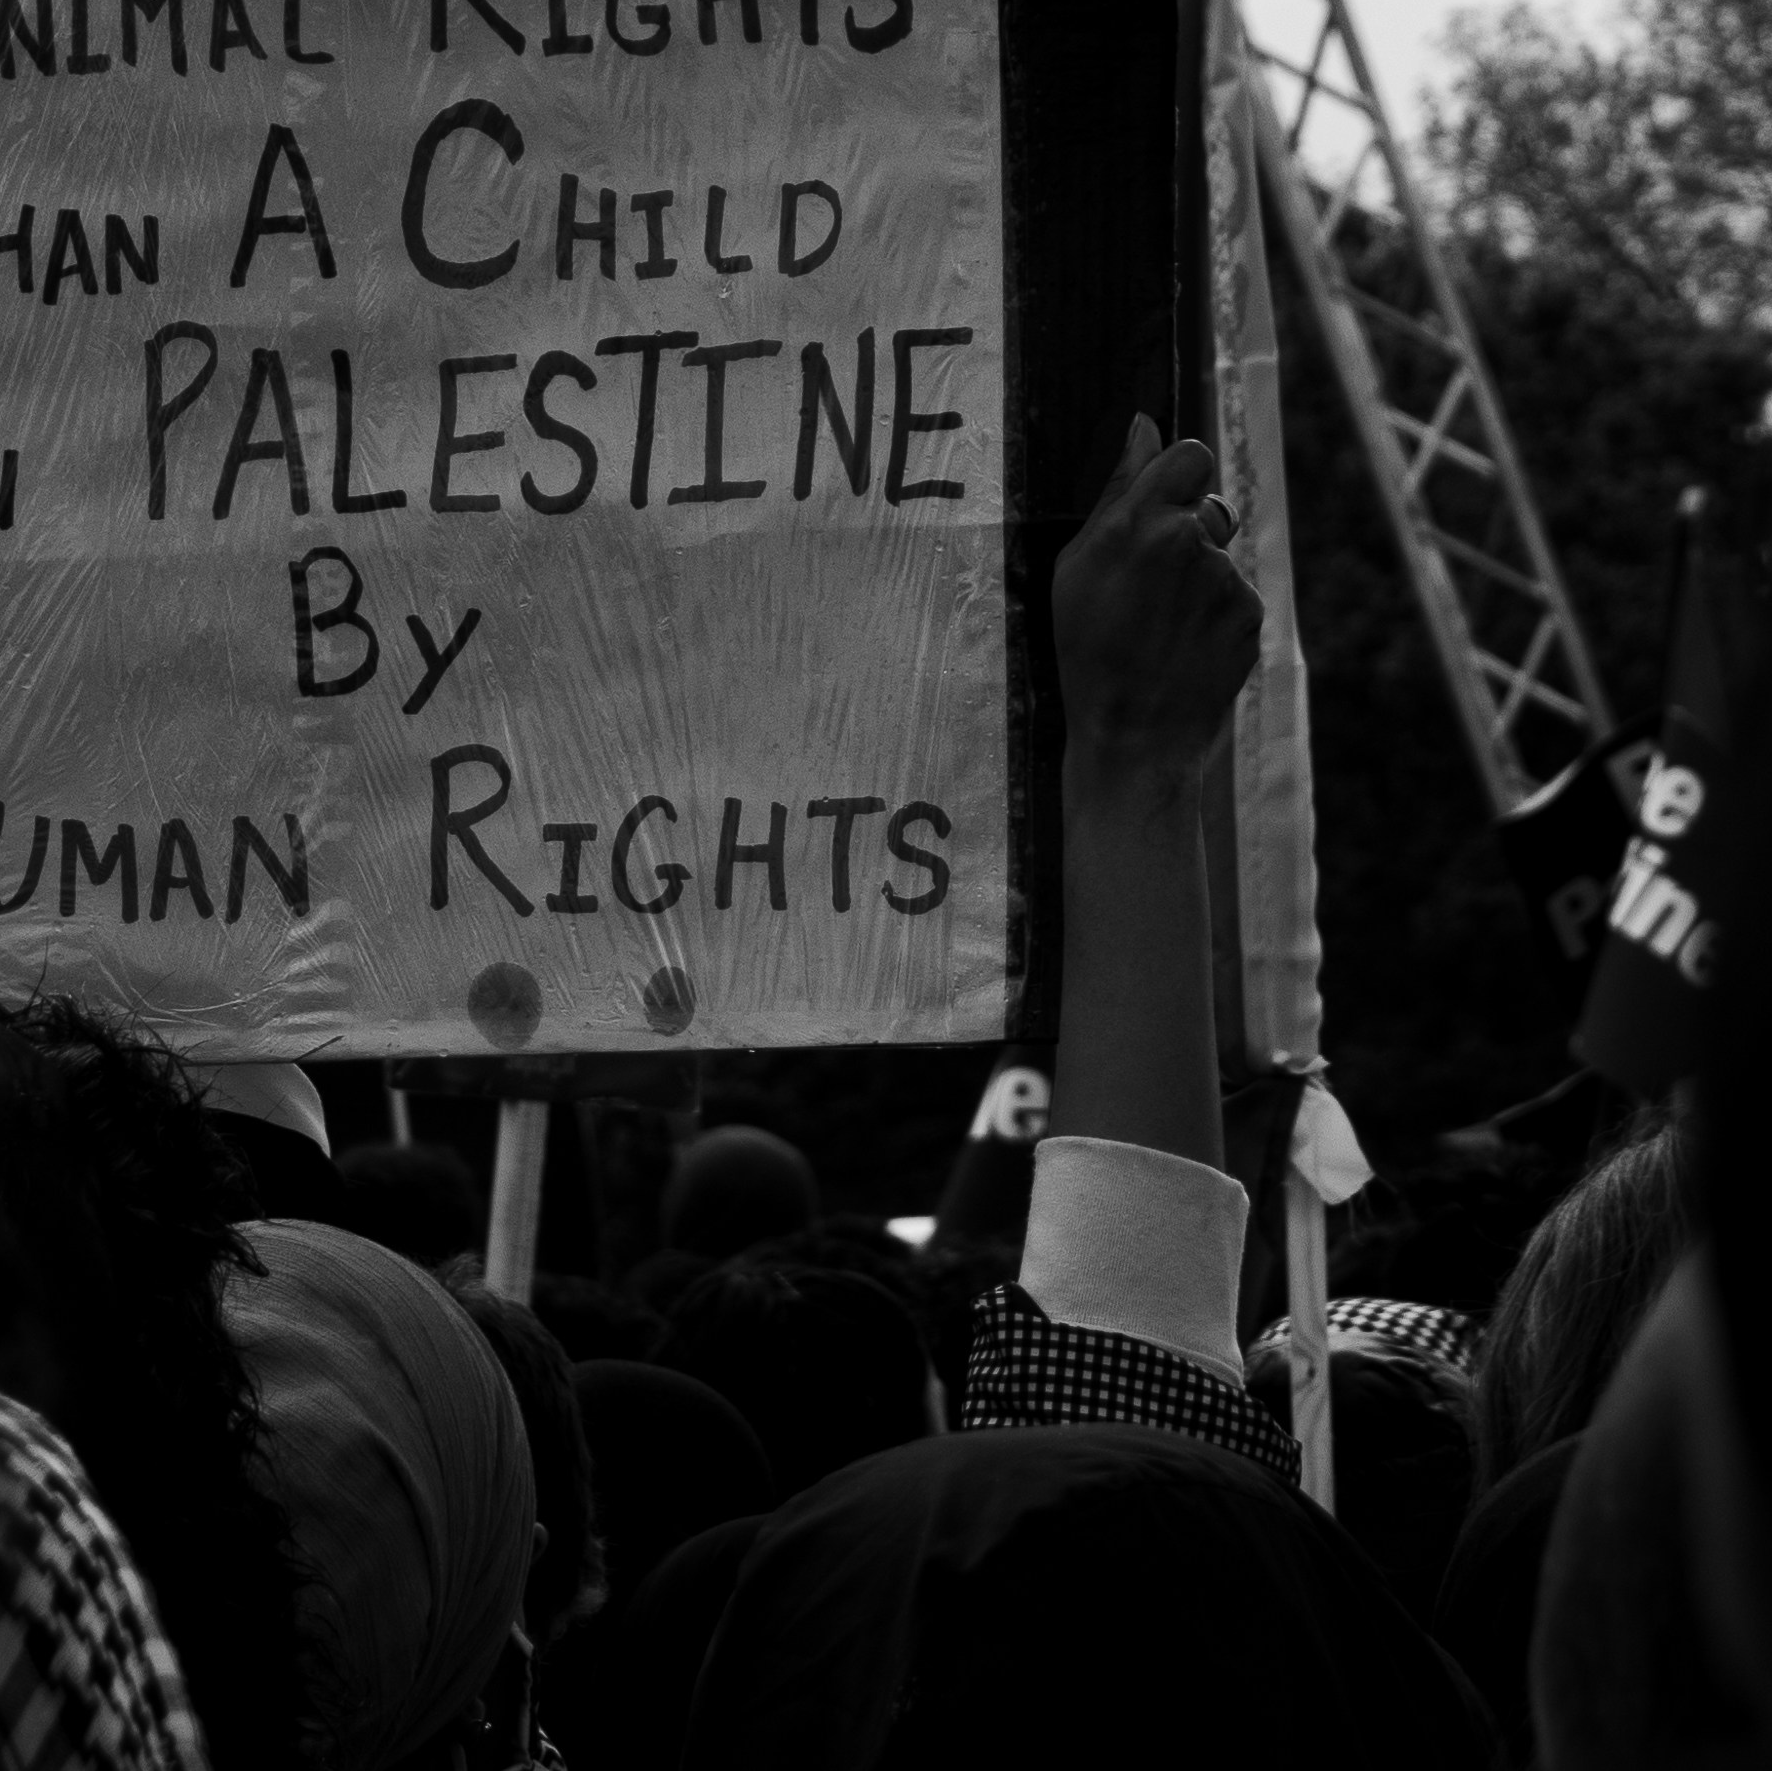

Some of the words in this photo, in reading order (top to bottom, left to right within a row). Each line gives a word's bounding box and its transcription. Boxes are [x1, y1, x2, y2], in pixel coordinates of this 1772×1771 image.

[231, 125, 335, 287] A
[402, 100, 841, 288] CHILD
[145, 323, 971, 518] PALESTINE
[431, 746, 951, 916] RIGHTS
